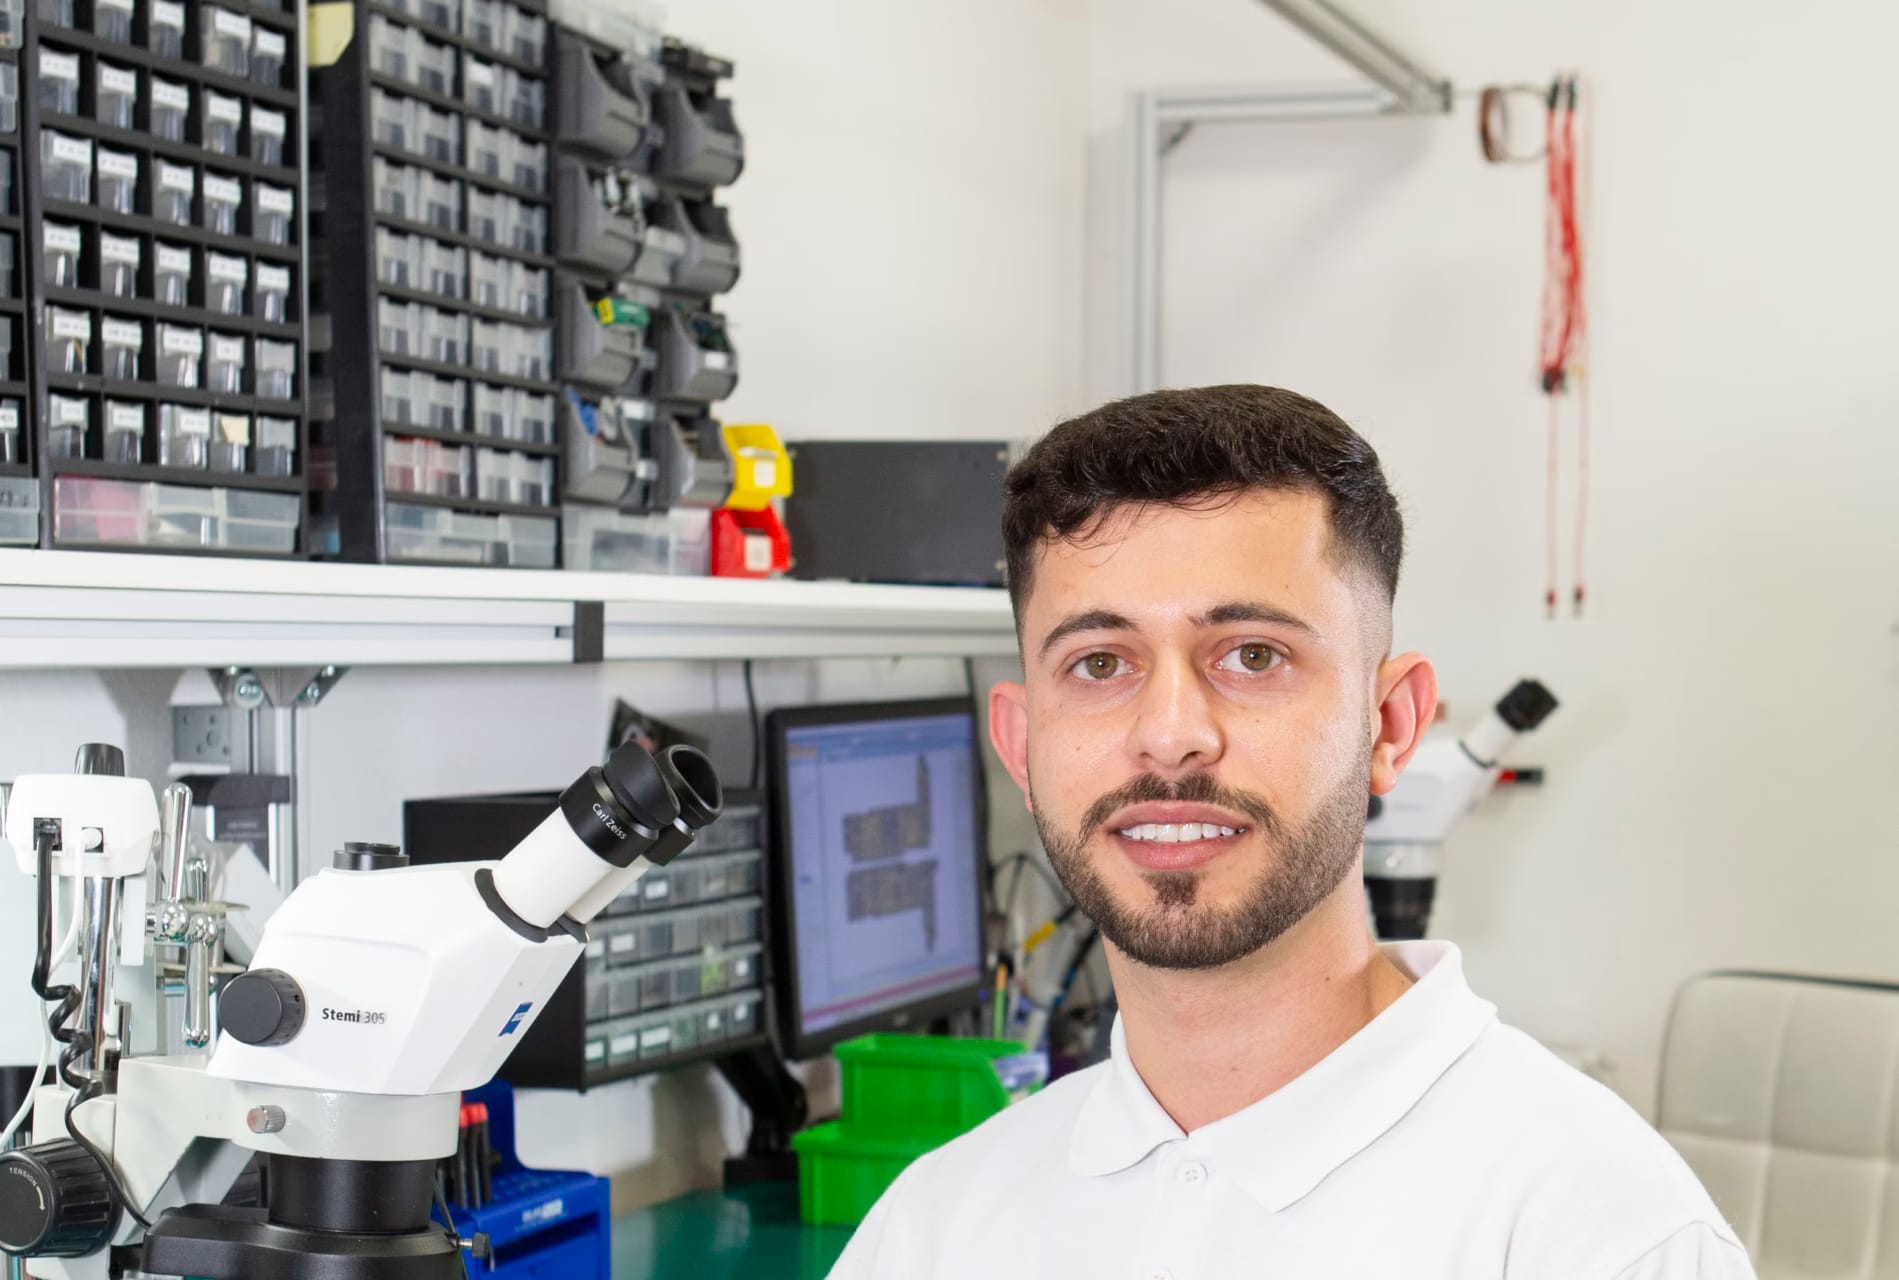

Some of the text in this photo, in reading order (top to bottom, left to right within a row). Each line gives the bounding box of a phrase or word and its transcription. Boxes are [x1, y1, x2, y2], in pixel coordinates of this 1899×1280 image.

[592, 803, 627, 840] Carl Zeiss
[322, 1007, 386, 1025] Stemi 305
[9, 1167, 37, 1187] TENSION
